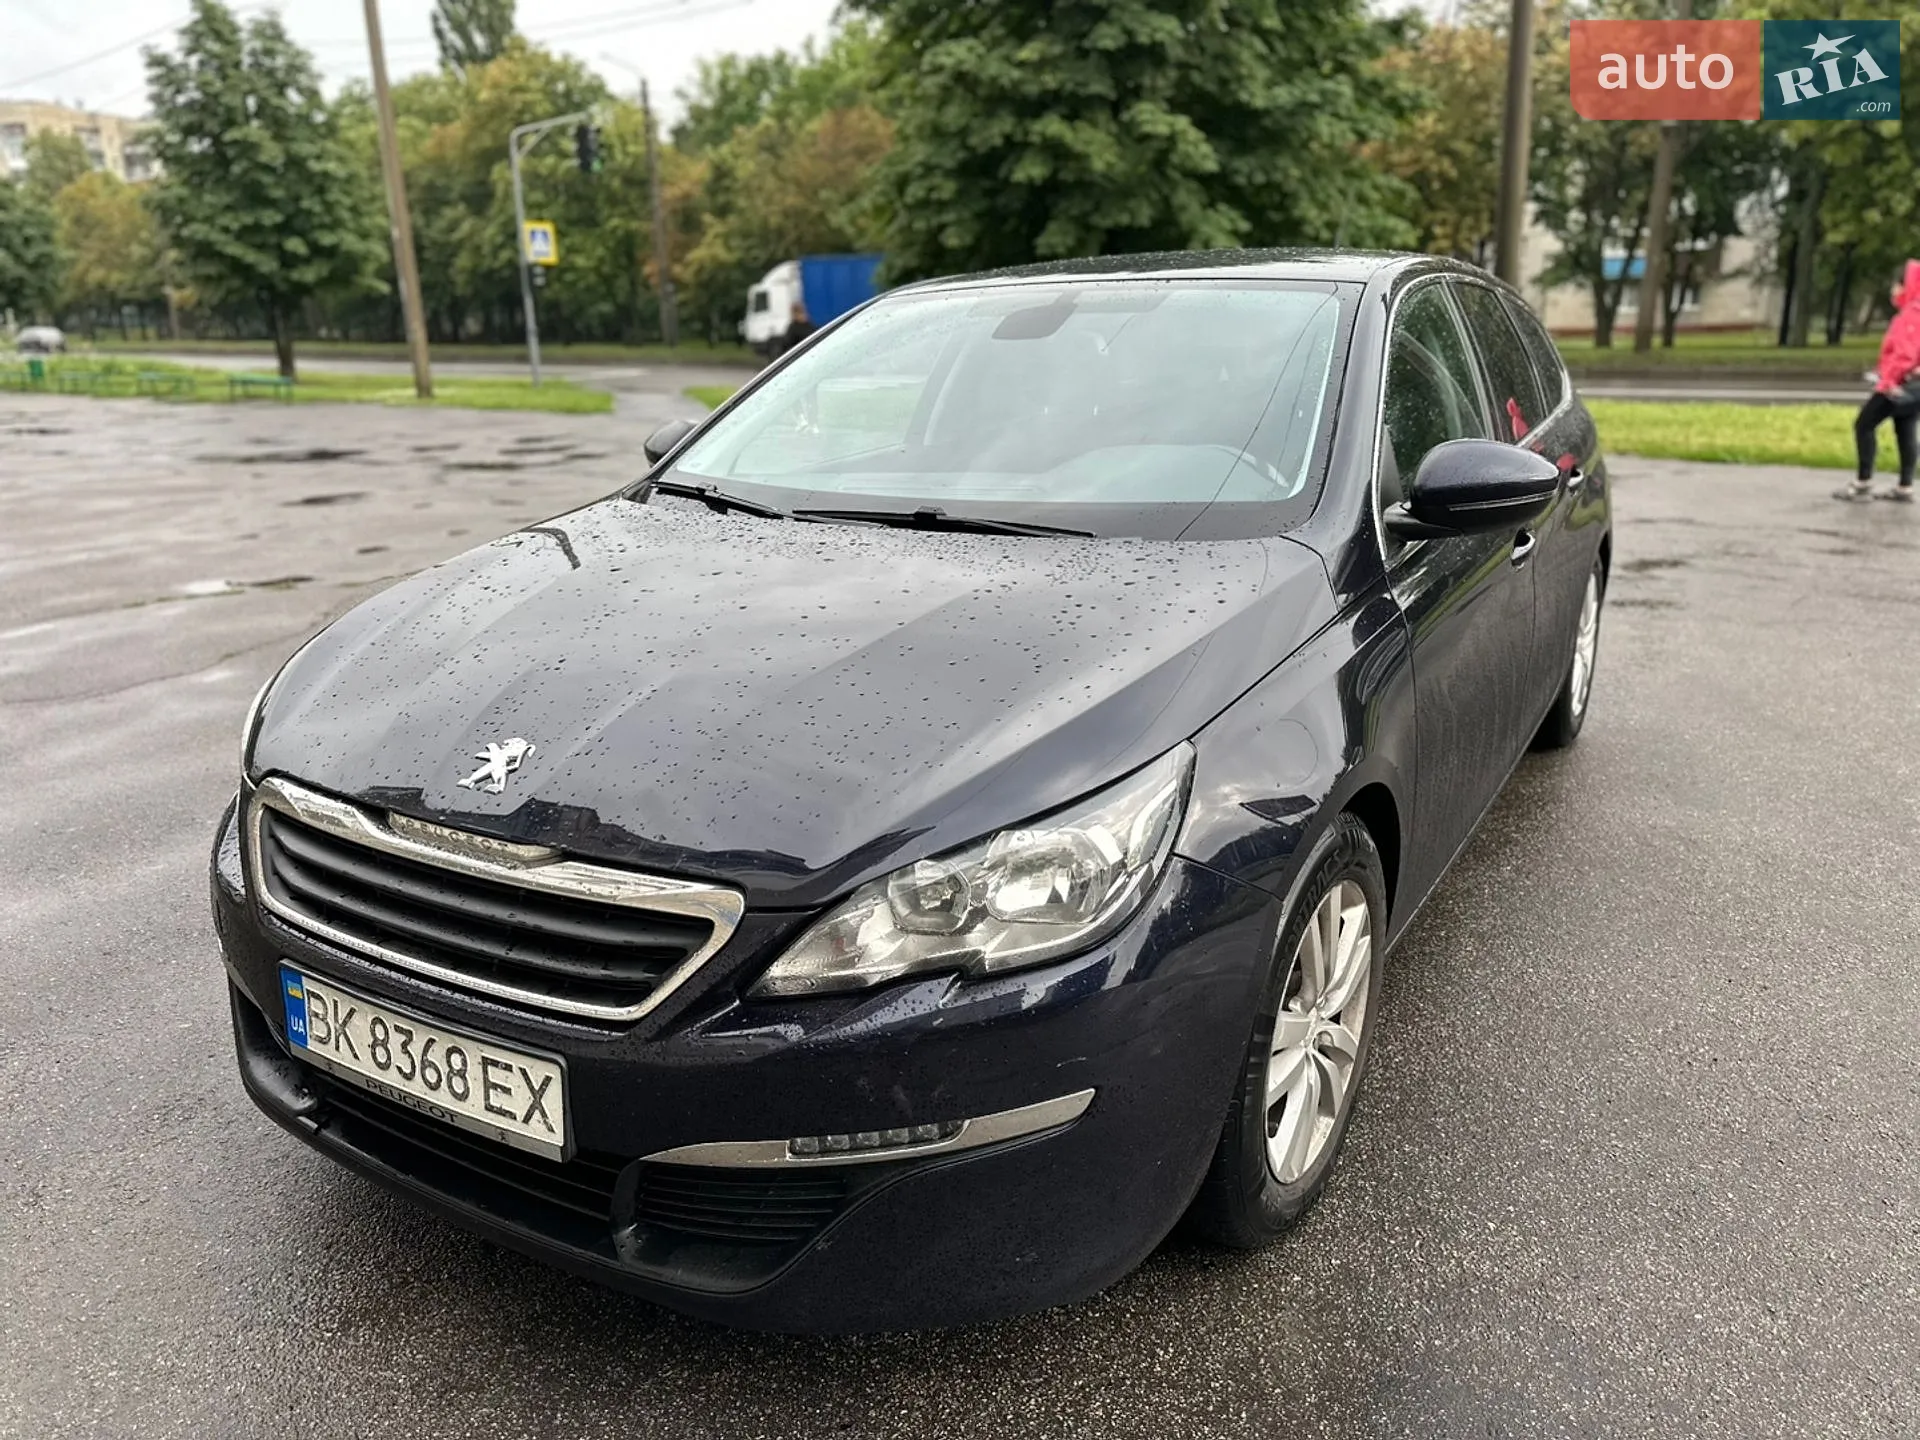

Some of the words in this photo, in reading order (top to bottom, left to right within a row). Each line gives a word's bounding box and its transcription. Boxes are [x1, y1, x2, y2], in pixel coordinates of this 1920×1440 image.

[291, 1015, 307, 1036] UA
[305, 988, 361, 1062] BK
[369, 1016, 471, 1102] 8368
[481, 1055, 557, 1135] EX
[365, 1079, 459, 1125] PEUGEOT
